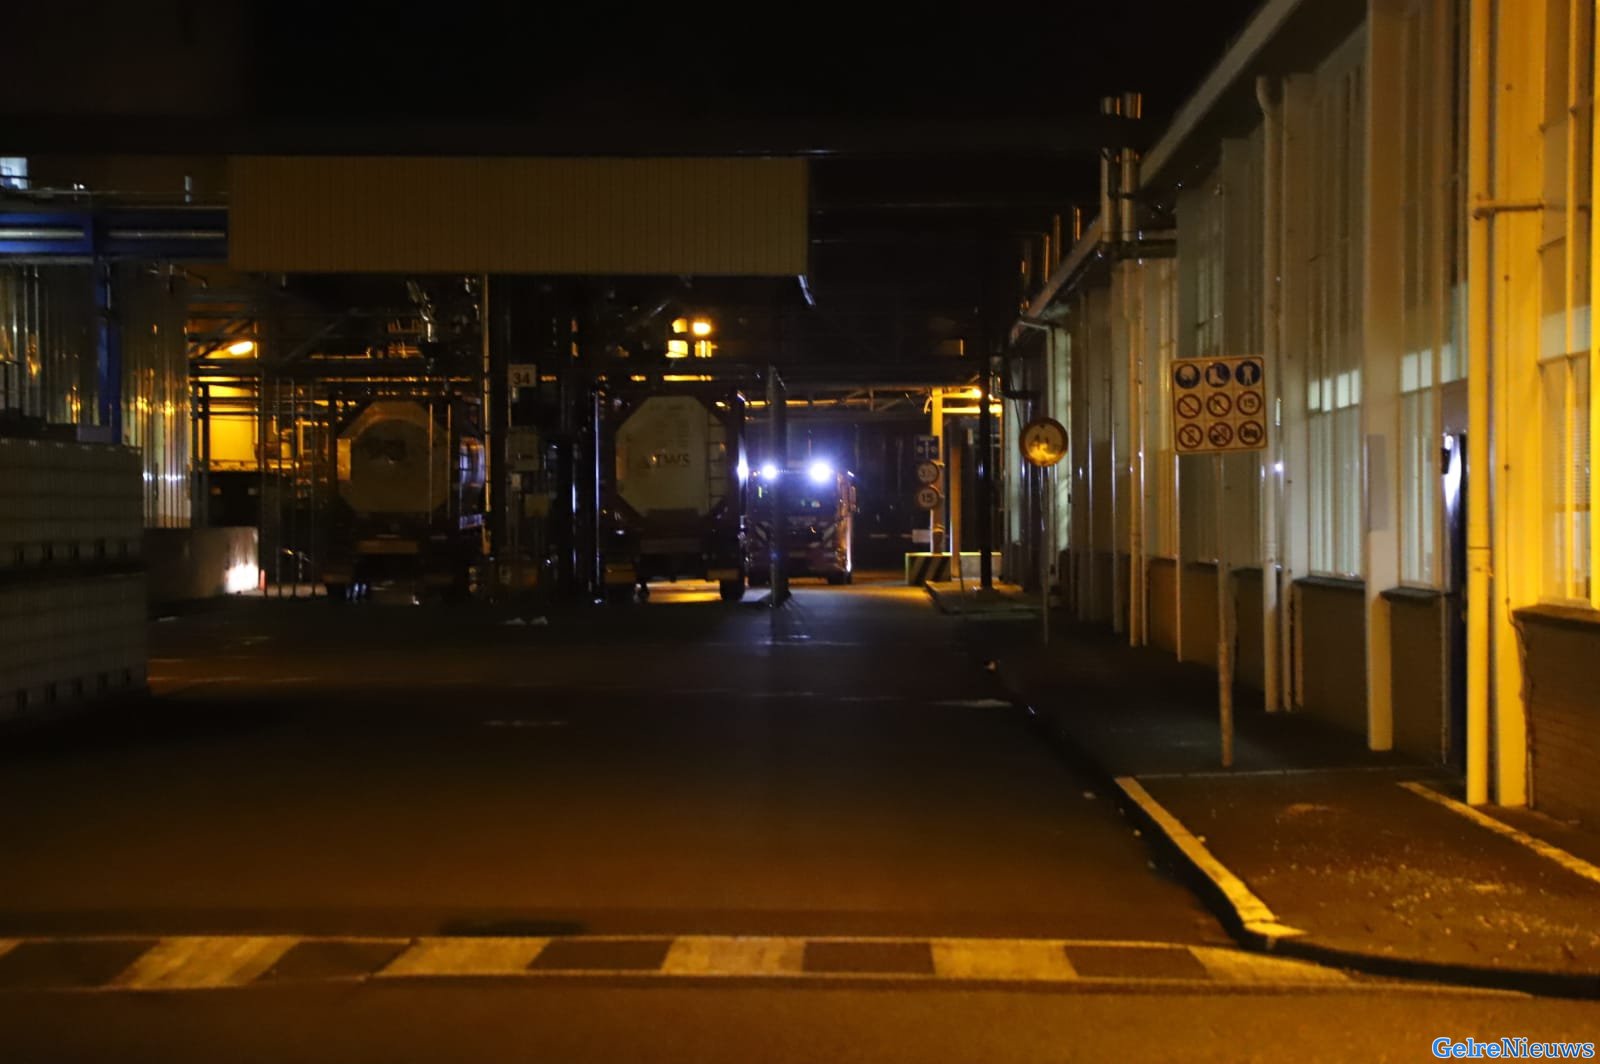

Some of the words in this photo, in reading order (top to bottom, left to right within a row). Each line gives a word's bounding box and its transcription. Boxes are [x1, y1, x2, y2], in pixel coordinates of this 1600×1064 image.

[513, 371, 530, 385] 34
[1243, 399, 1255, 408] 15
[921, 493, 933, 503] 15
